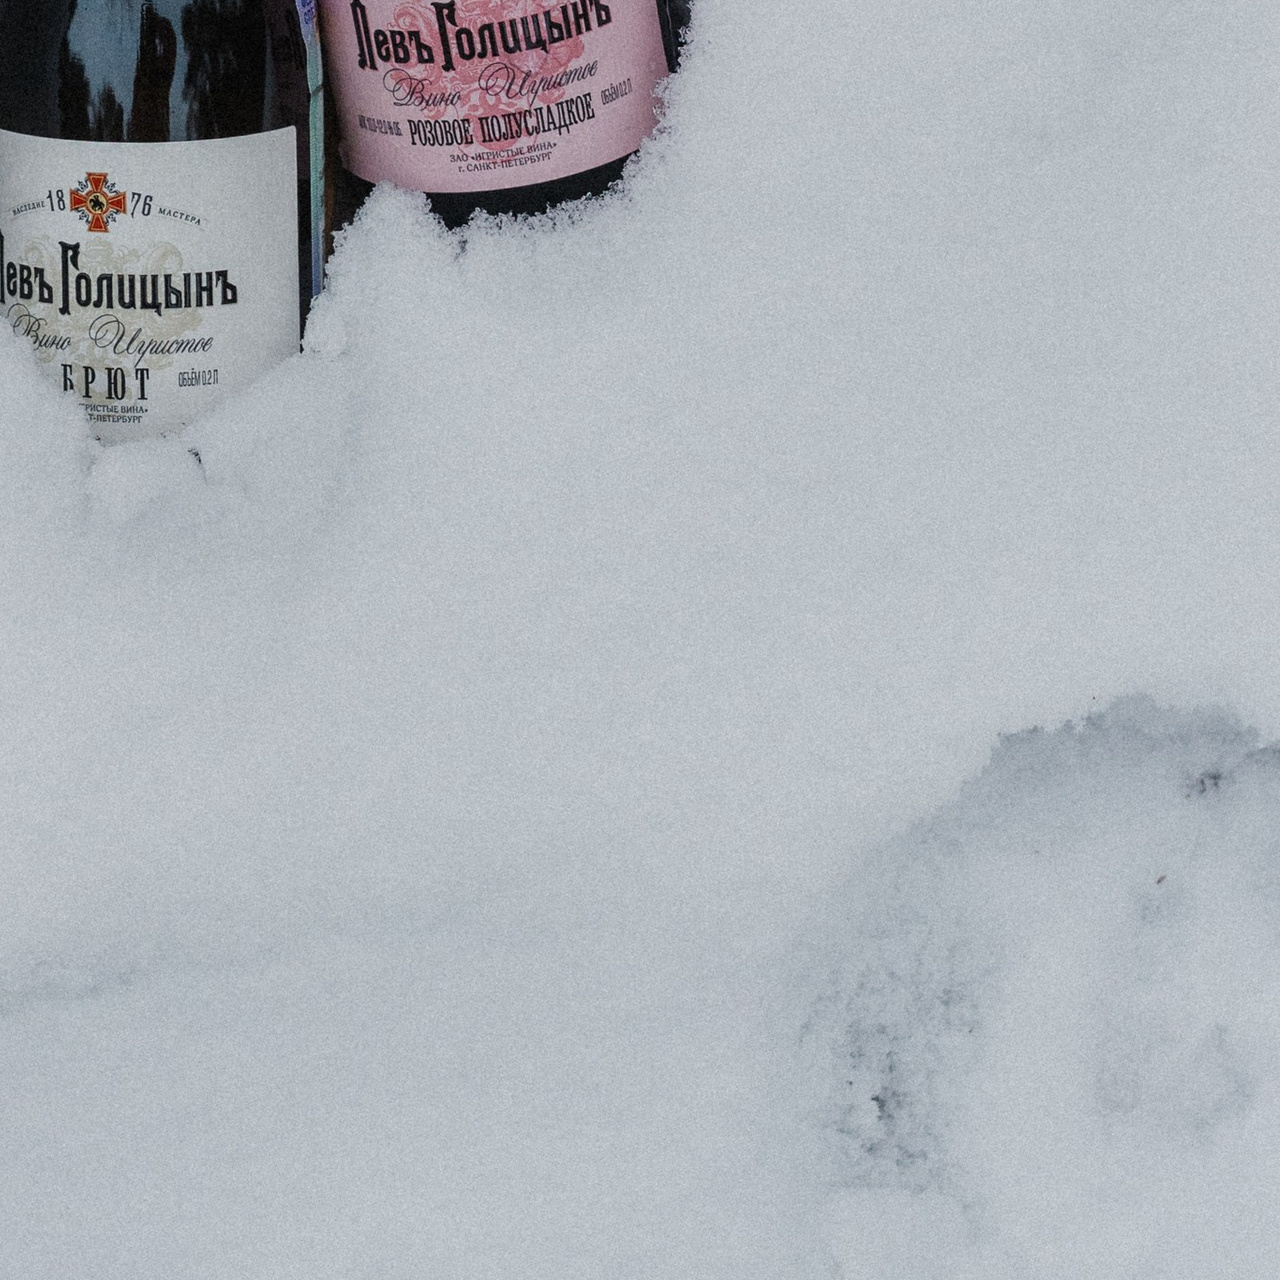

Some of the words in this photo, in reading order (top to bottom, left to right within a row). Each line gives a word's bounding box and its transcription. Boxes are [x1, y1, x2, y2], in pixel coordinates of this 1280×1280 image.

[382, 68, 461, 111] Вино
[478, 58, 598, 107] Игристое
[407, 118, 474, 146] РОЗОВОЕ
[478, 92, 595, 143] ПОЛУСЛАДКОЕ
[450, 154, 468, 163] ЗАО
[467, 152, 552, 172] САНКТ-ПЕТЕРБУРГ
[46, 189, 66, 212] 18
[130, 192, 153, 218] 76
[158, 207, 201, 226] МАСТЕРА
[58, 241, 238, 317] Голицынъ
[7, 303, 71, 351] Вино
[89, 313, 214, 368] Игристое
[61, 364, 150, 401] БРЮТ
[79, 403, 119, 413] РИСТЫЕ
[88, 413, 143, 424] Т-ПЕТЕРБУРГ
